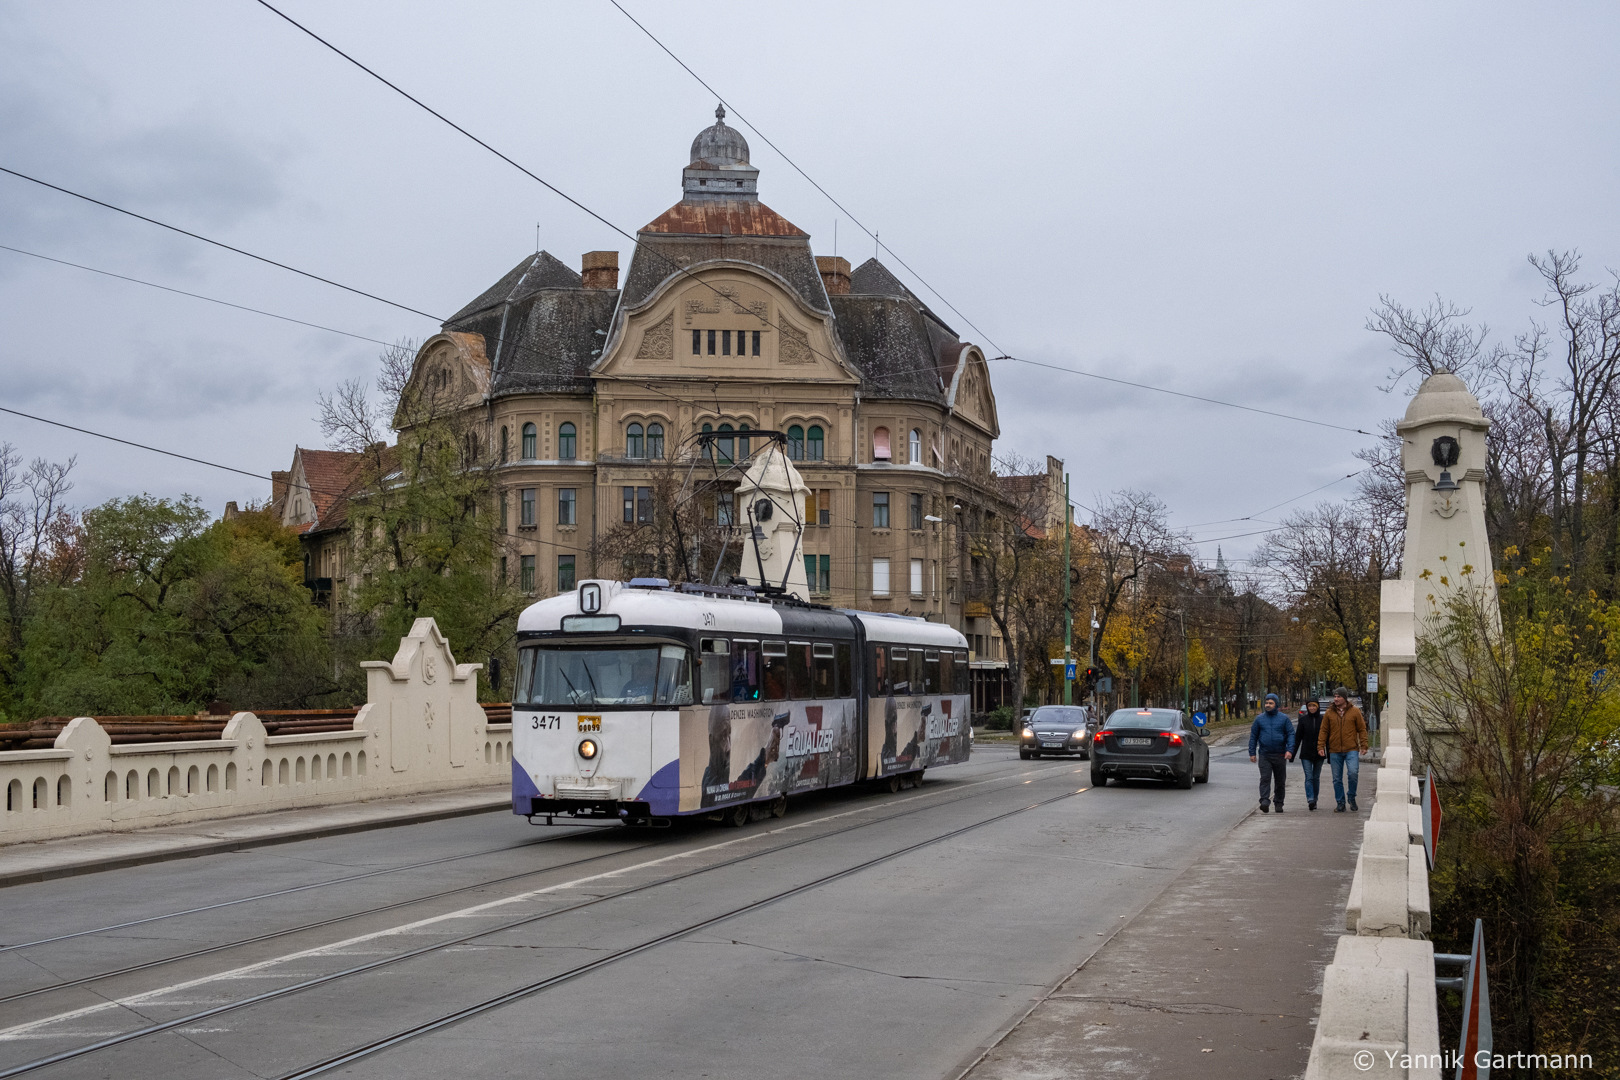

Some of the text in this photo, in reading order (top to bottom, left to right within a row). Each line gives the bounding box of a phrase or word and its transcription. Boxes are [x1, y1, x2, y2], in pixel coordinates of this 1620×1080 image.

[586, 591, 597, 611] 1
[702, 612, 716, 626] 3471
[730, 707, 775, 720] DENZEL WASHINGTON
[532, 716, 561, 730] 3471
[785, 726, 834, 758] EQUALIZER
